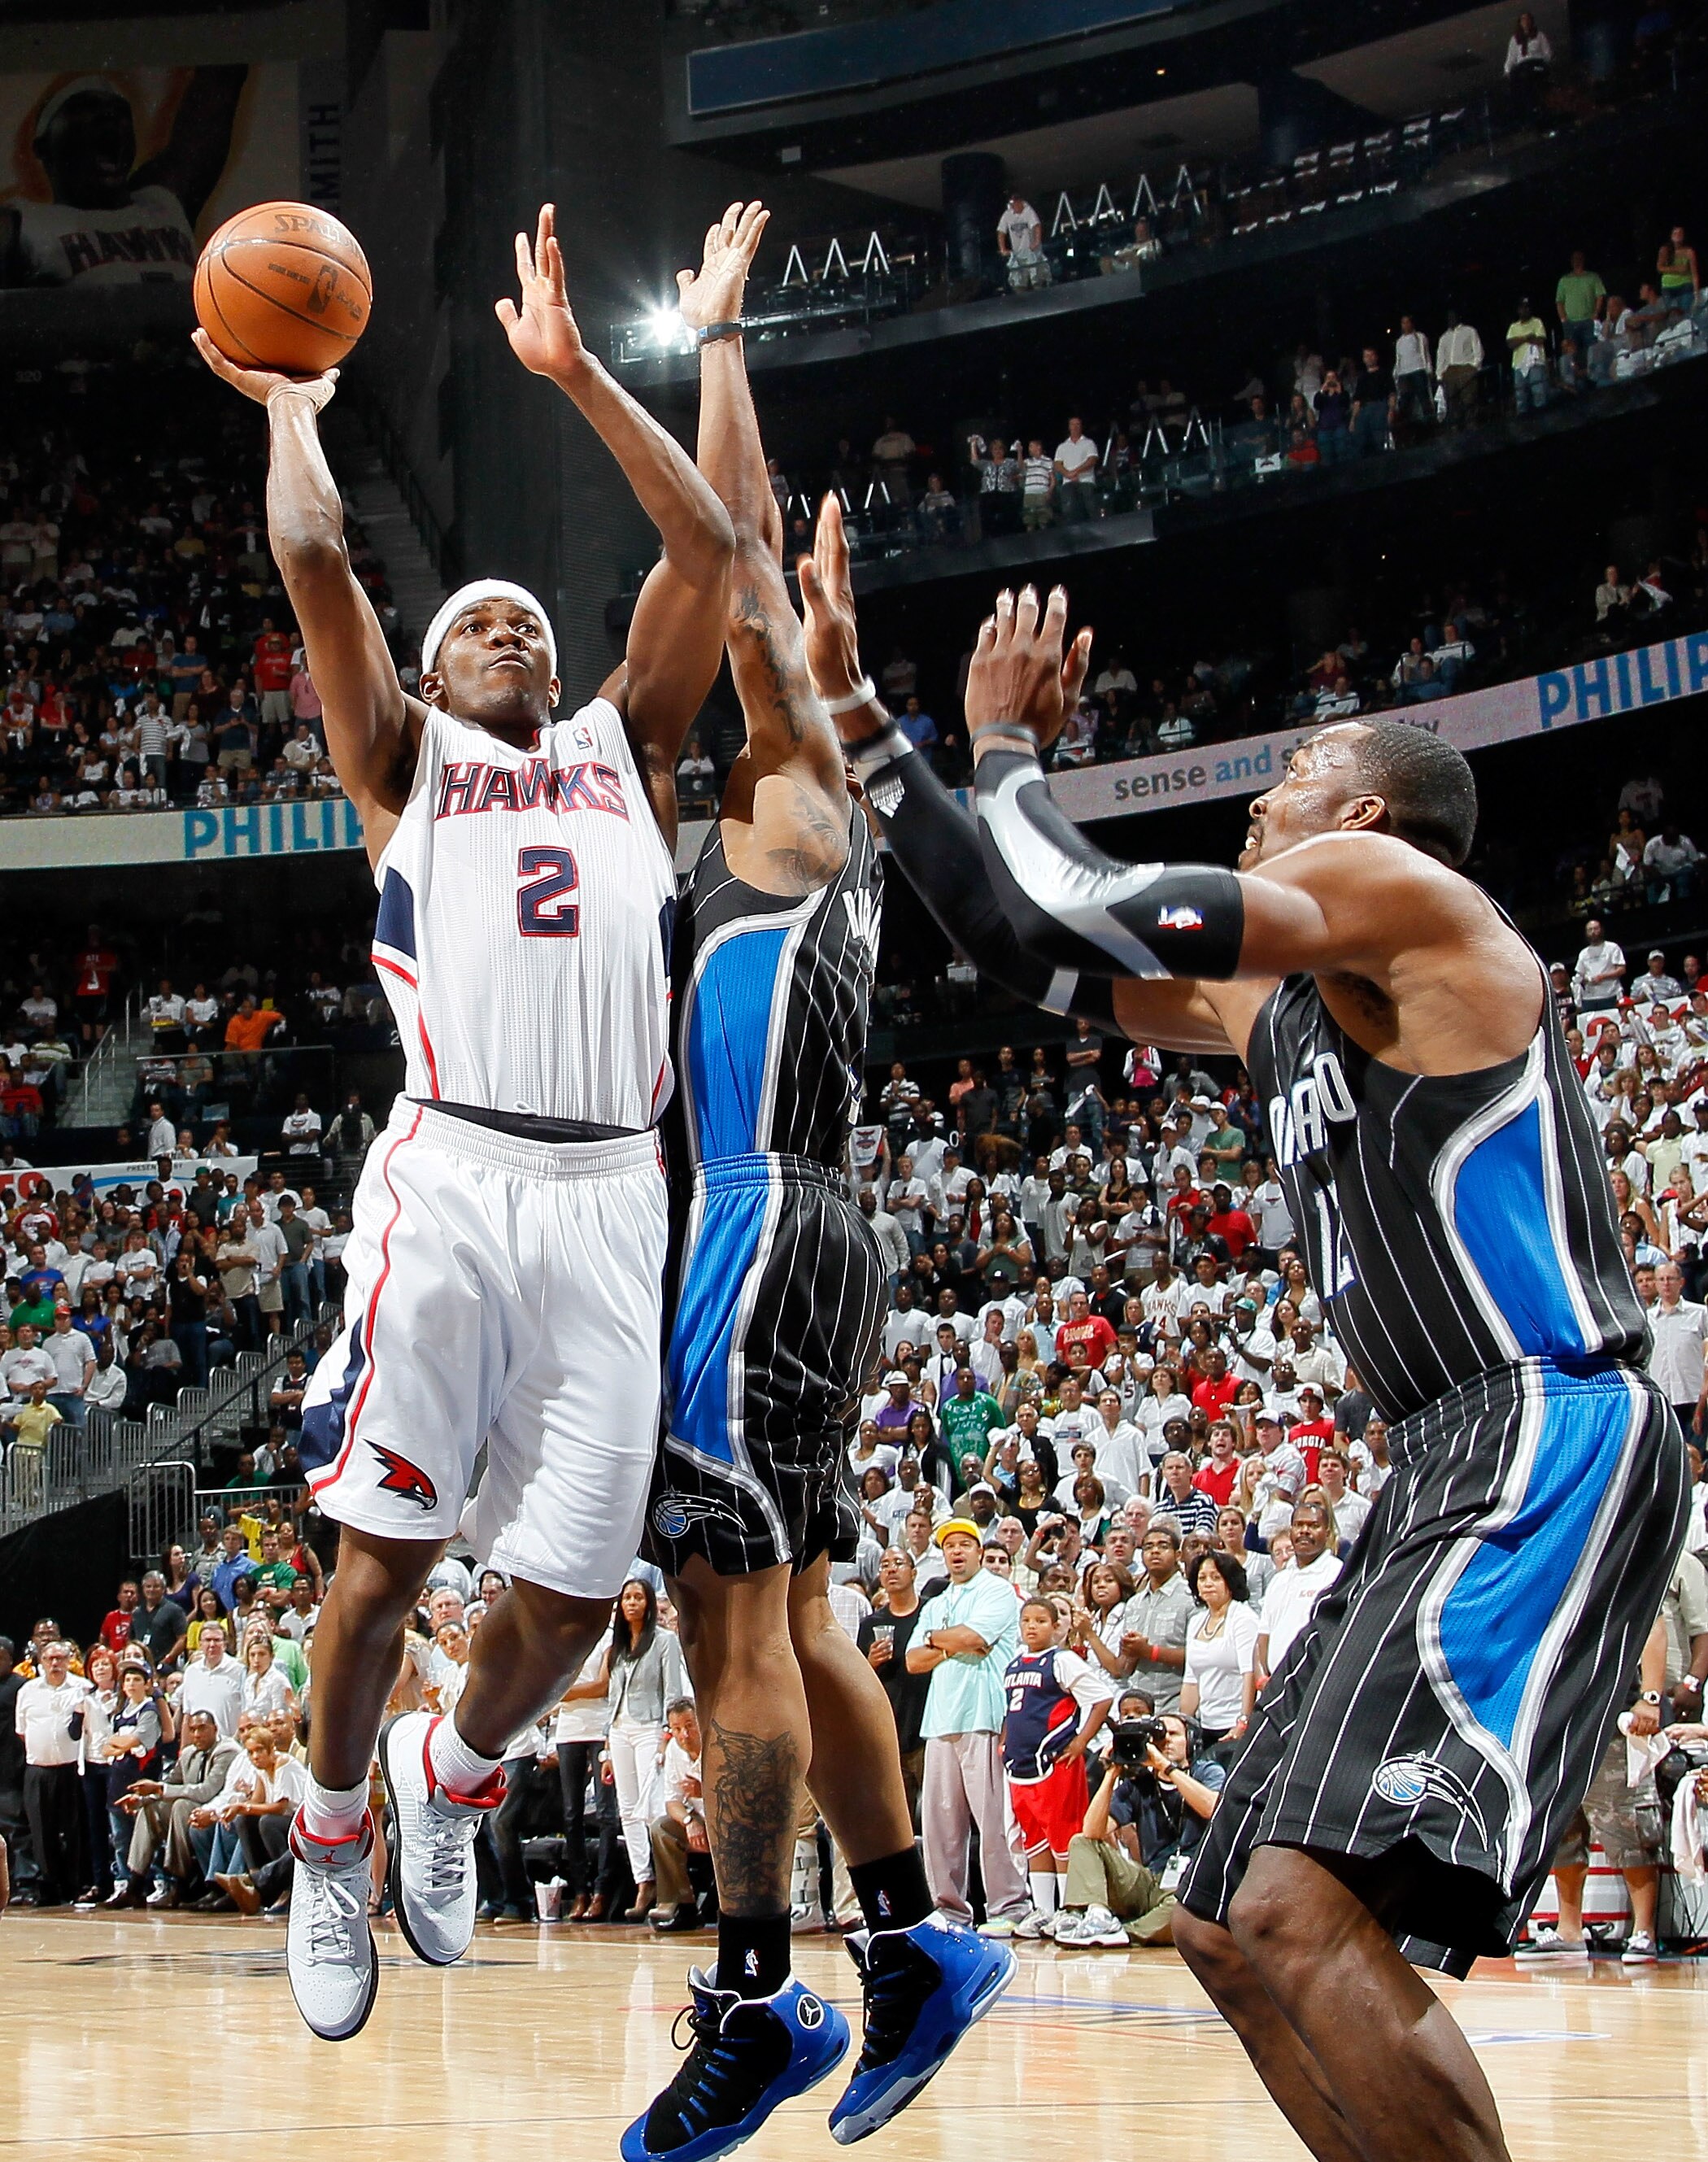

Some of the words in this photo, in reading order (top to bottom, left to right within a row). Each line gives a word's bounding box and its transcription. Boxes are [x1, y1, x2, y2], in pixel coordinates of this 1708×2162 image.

[308, 104, 340, 202] MITH
[434, 758, 630, 823] HAWKS
[1114, 765, 1207, 801] sense
[1214, 745, 1273, 783] and
[517, 845, 579, 937] 2
[1004, 1672, 1042, 1689] ATLANTA
[1009, 1688, 1025, 1712] 2
